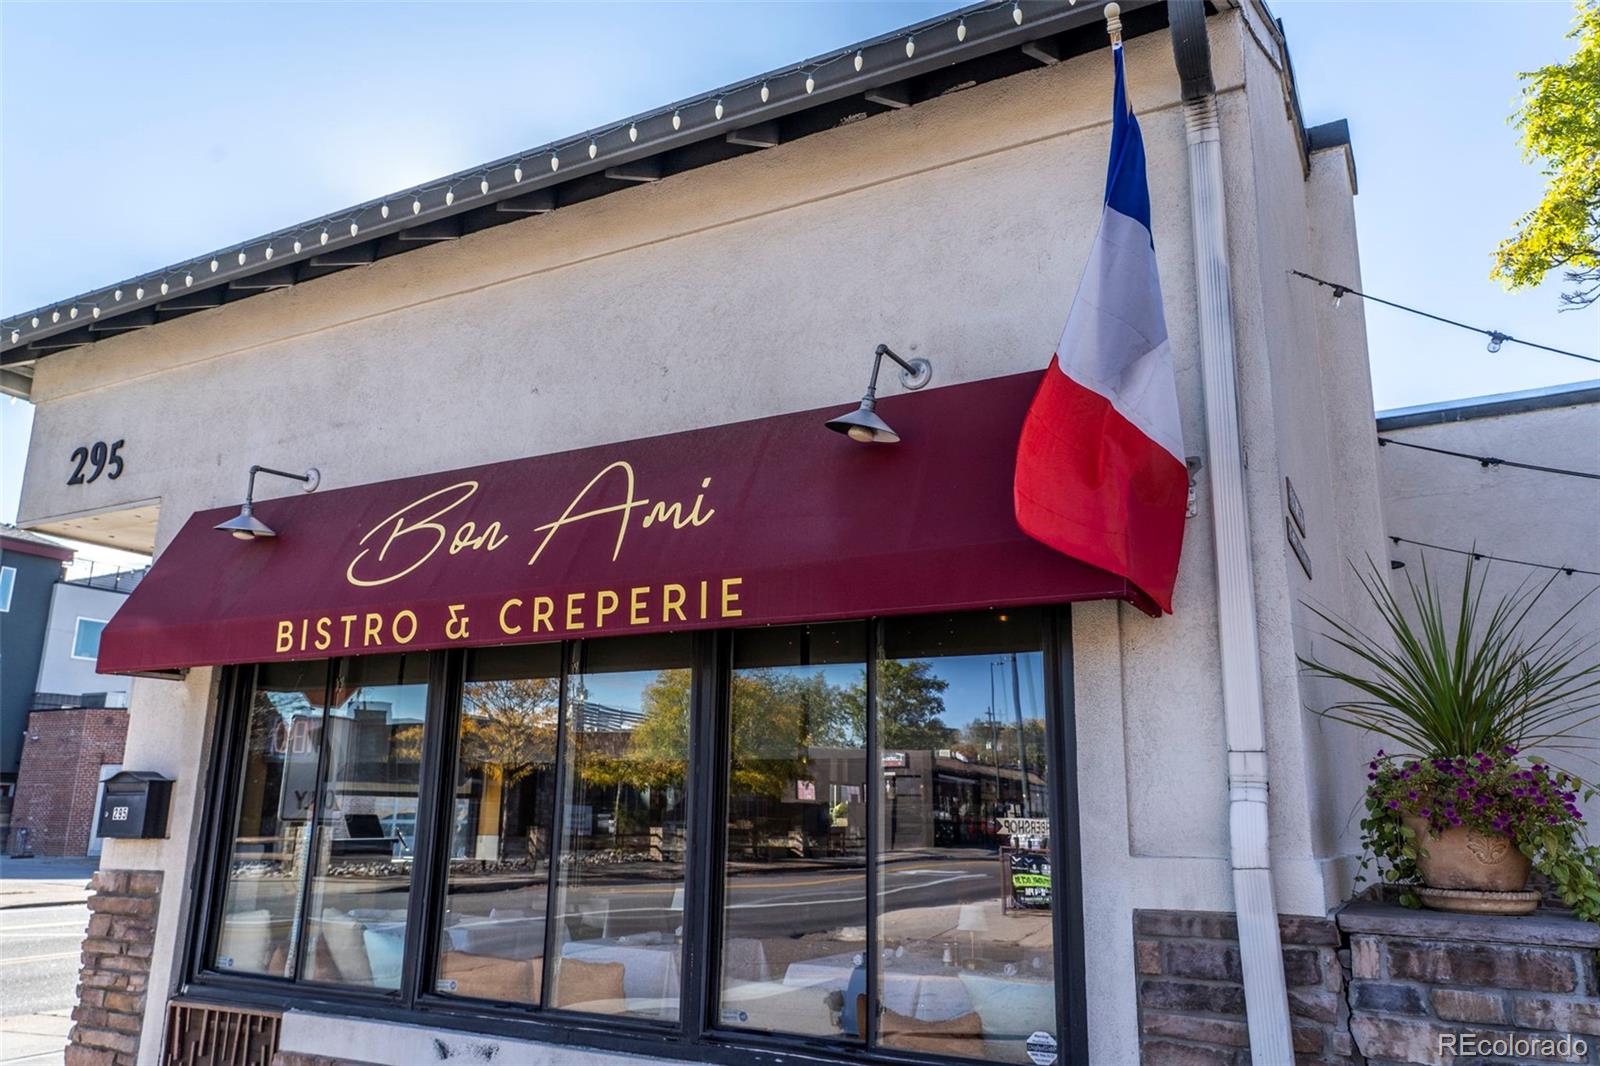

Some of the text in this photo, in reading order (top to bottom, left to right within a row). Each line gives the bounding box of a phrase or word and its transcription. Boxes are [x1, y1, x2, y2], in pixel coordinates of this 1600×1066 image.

[66, 439, 125, 486] 295
[346, 460, 715, 587] Bon Ami
[275, 577, 743, 653] BISTRO & CREPERIE
[112, 806, 129, 821] 295
